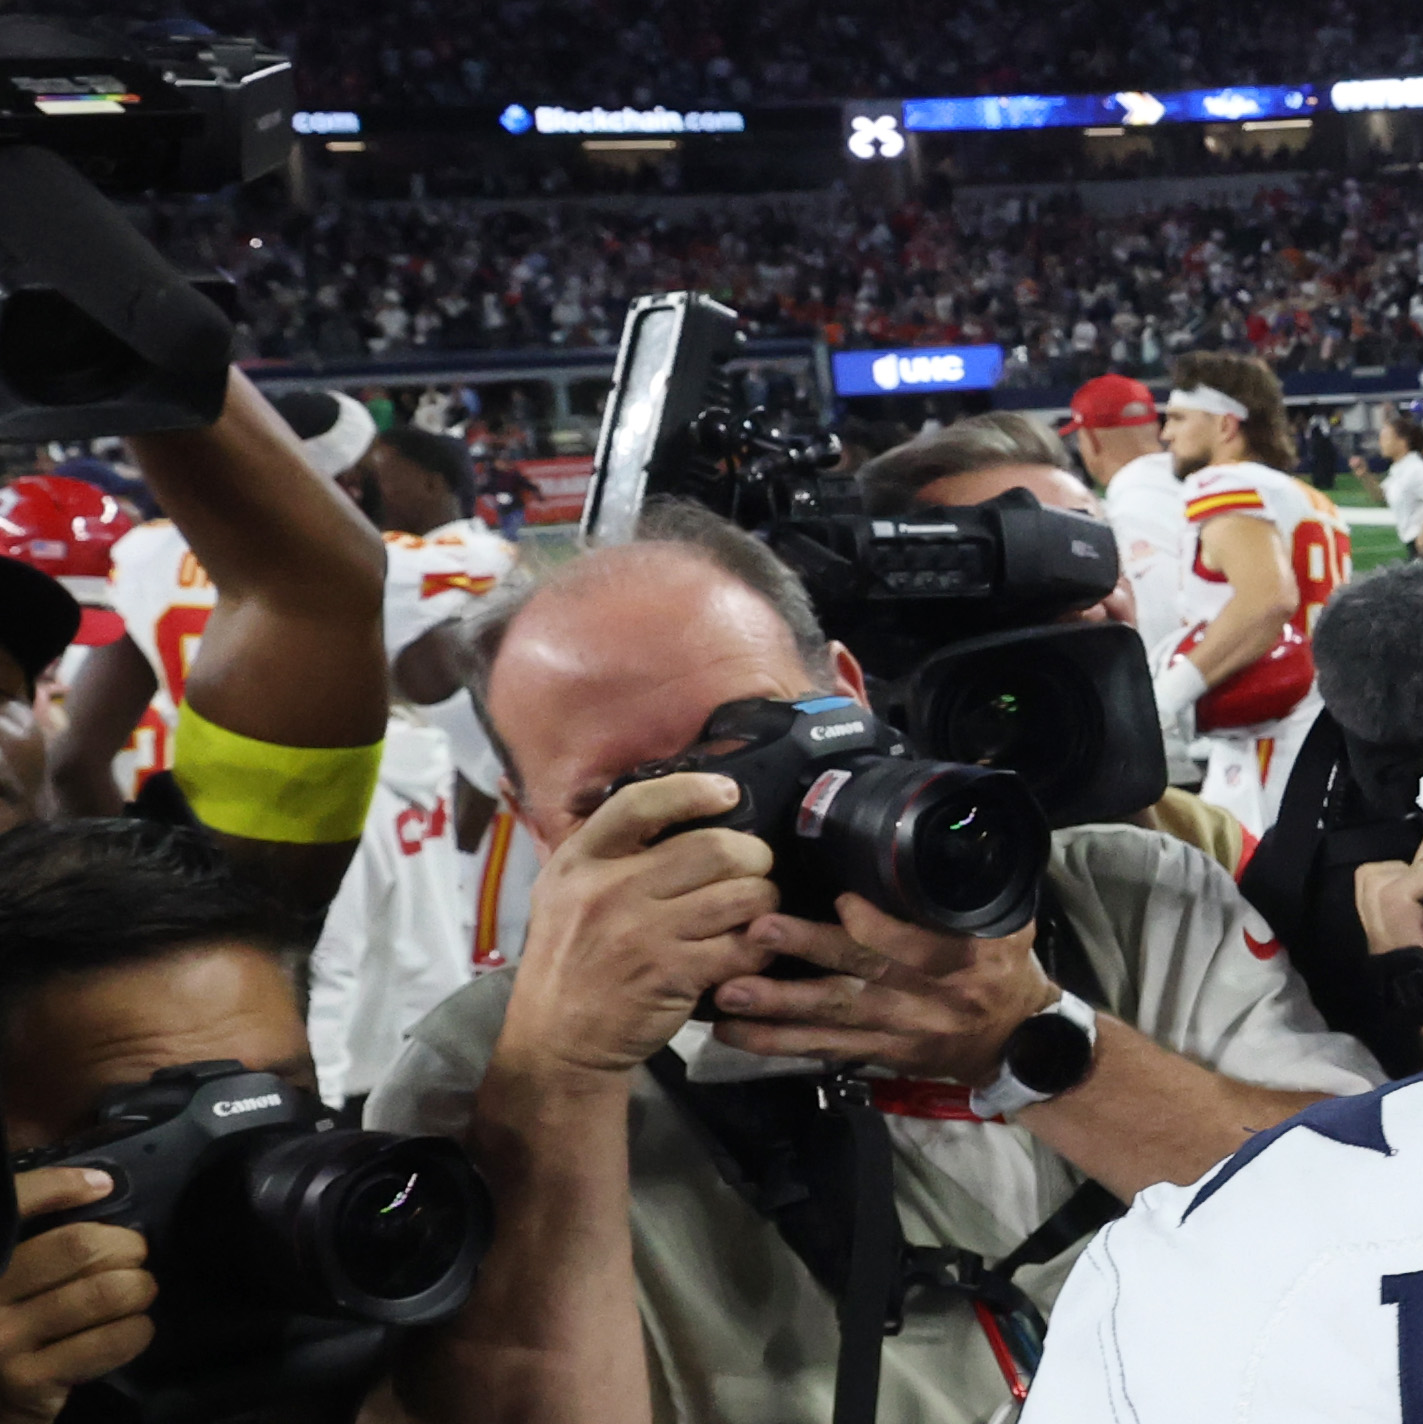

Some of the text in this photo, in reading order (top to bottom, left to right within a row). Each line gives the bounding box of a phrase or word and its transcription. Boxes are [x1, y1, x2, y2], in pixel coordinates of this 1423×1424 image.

[899, 355, 966, 383] UHC
[810, 721, 865, 741] Canon
[212, 1093, 282, 1118] Canon
